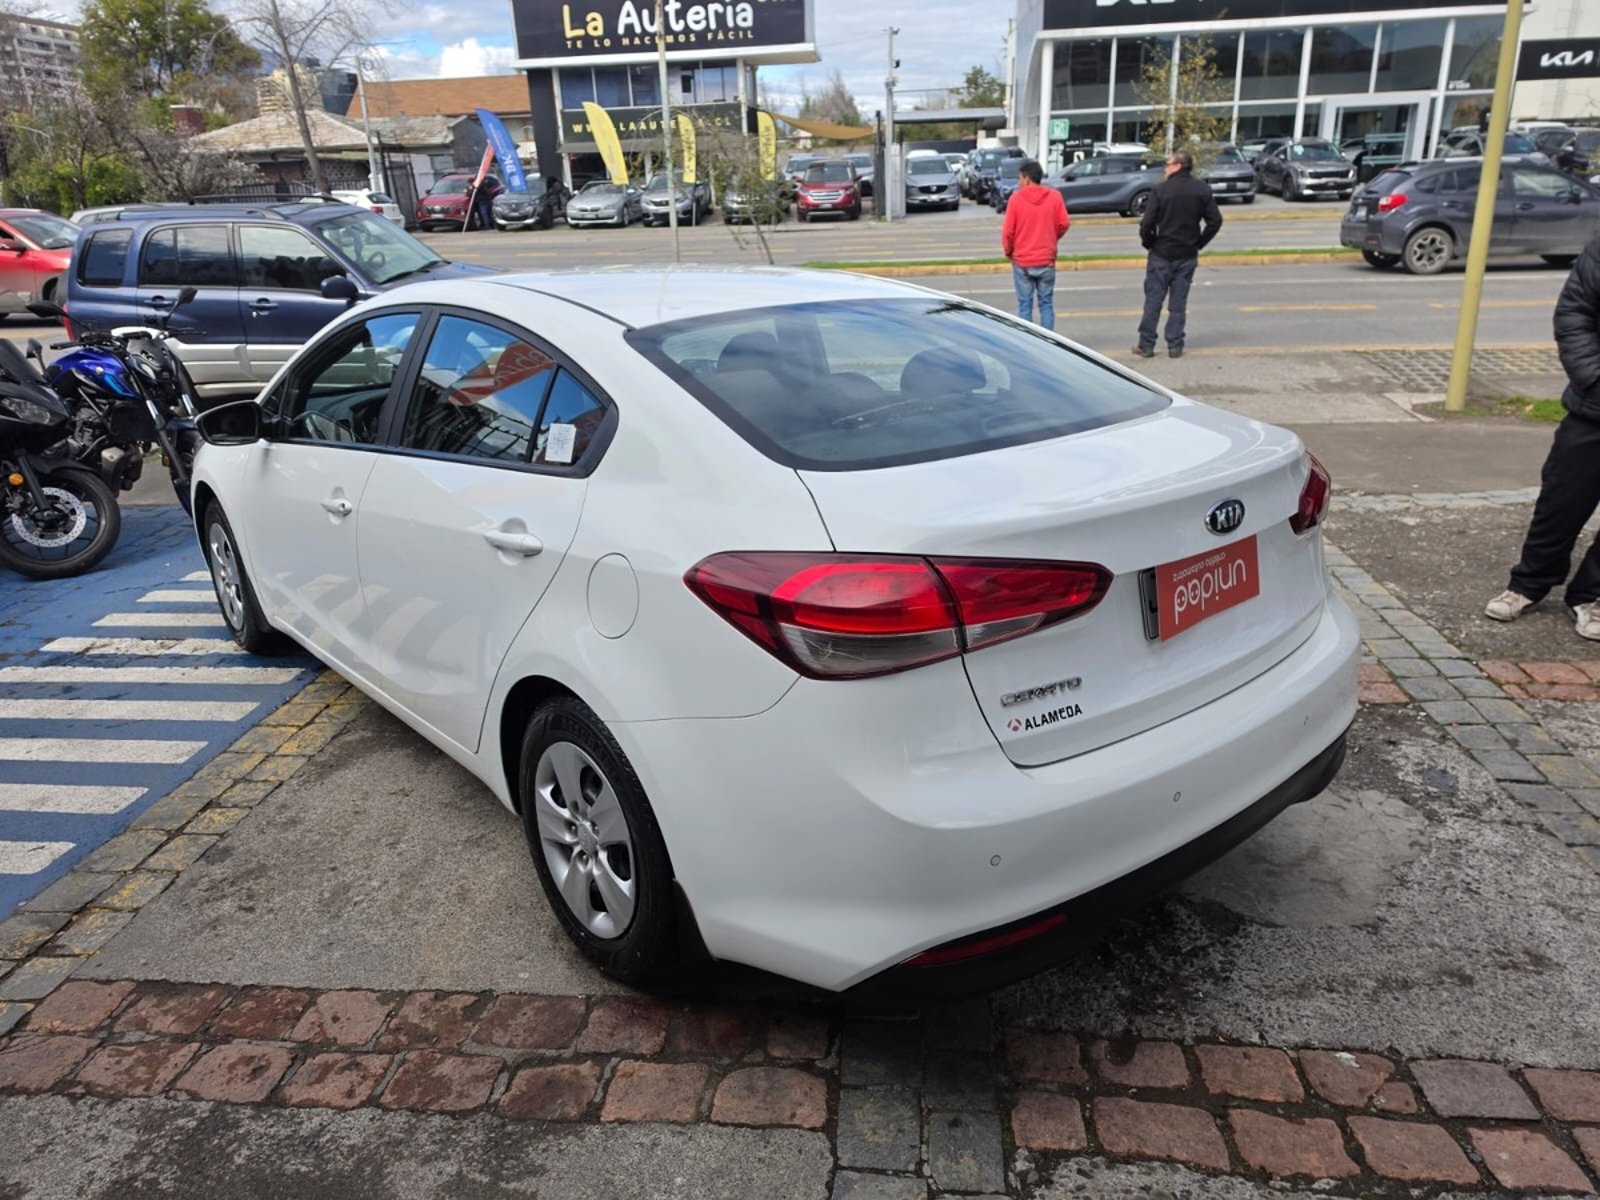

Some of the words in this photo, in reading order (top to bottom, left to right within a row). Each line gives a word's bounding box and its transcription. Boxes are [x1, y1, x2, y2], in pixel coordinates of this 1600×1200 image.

[562, 4, 604, 39] La
[566, 40, 583, 48] TE
[594, 38, 611, 47] LO
[707, 29, 754, 41] FÁCIL
[1540, 49, 1594, 67] KIA
[1214, 503, 1245, 531] KIA
[1173, 557, 1247, 625] unidad
[1000, 677, 1082, 708] CERATO
[1024, 703, 1083, 731] ALAMEDA
